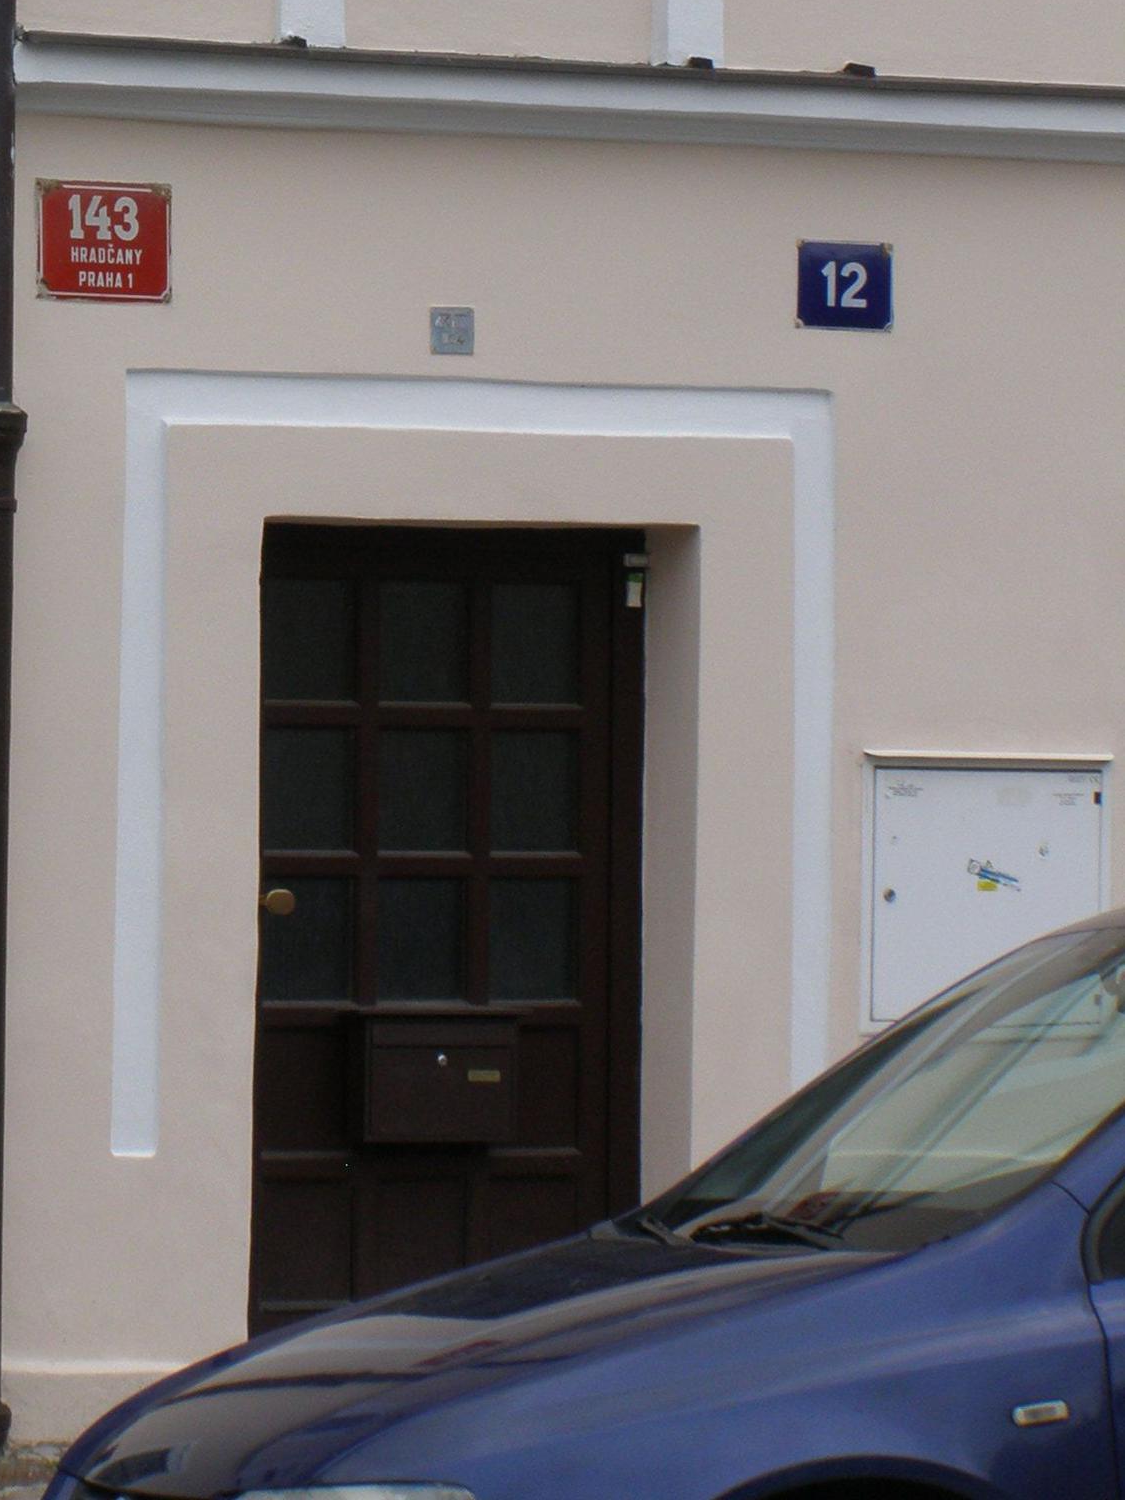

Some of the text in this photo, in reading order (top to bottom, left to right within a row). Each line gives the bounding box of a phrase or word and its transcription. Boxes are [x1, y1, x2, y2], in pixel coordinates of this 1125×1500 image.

[68, 194, 140, 242] 143
[70, 243, 143, 266] HRADČANY
[78, 270, 134, 289] PRAHA 1
[820, 260, 868, 308] 12
